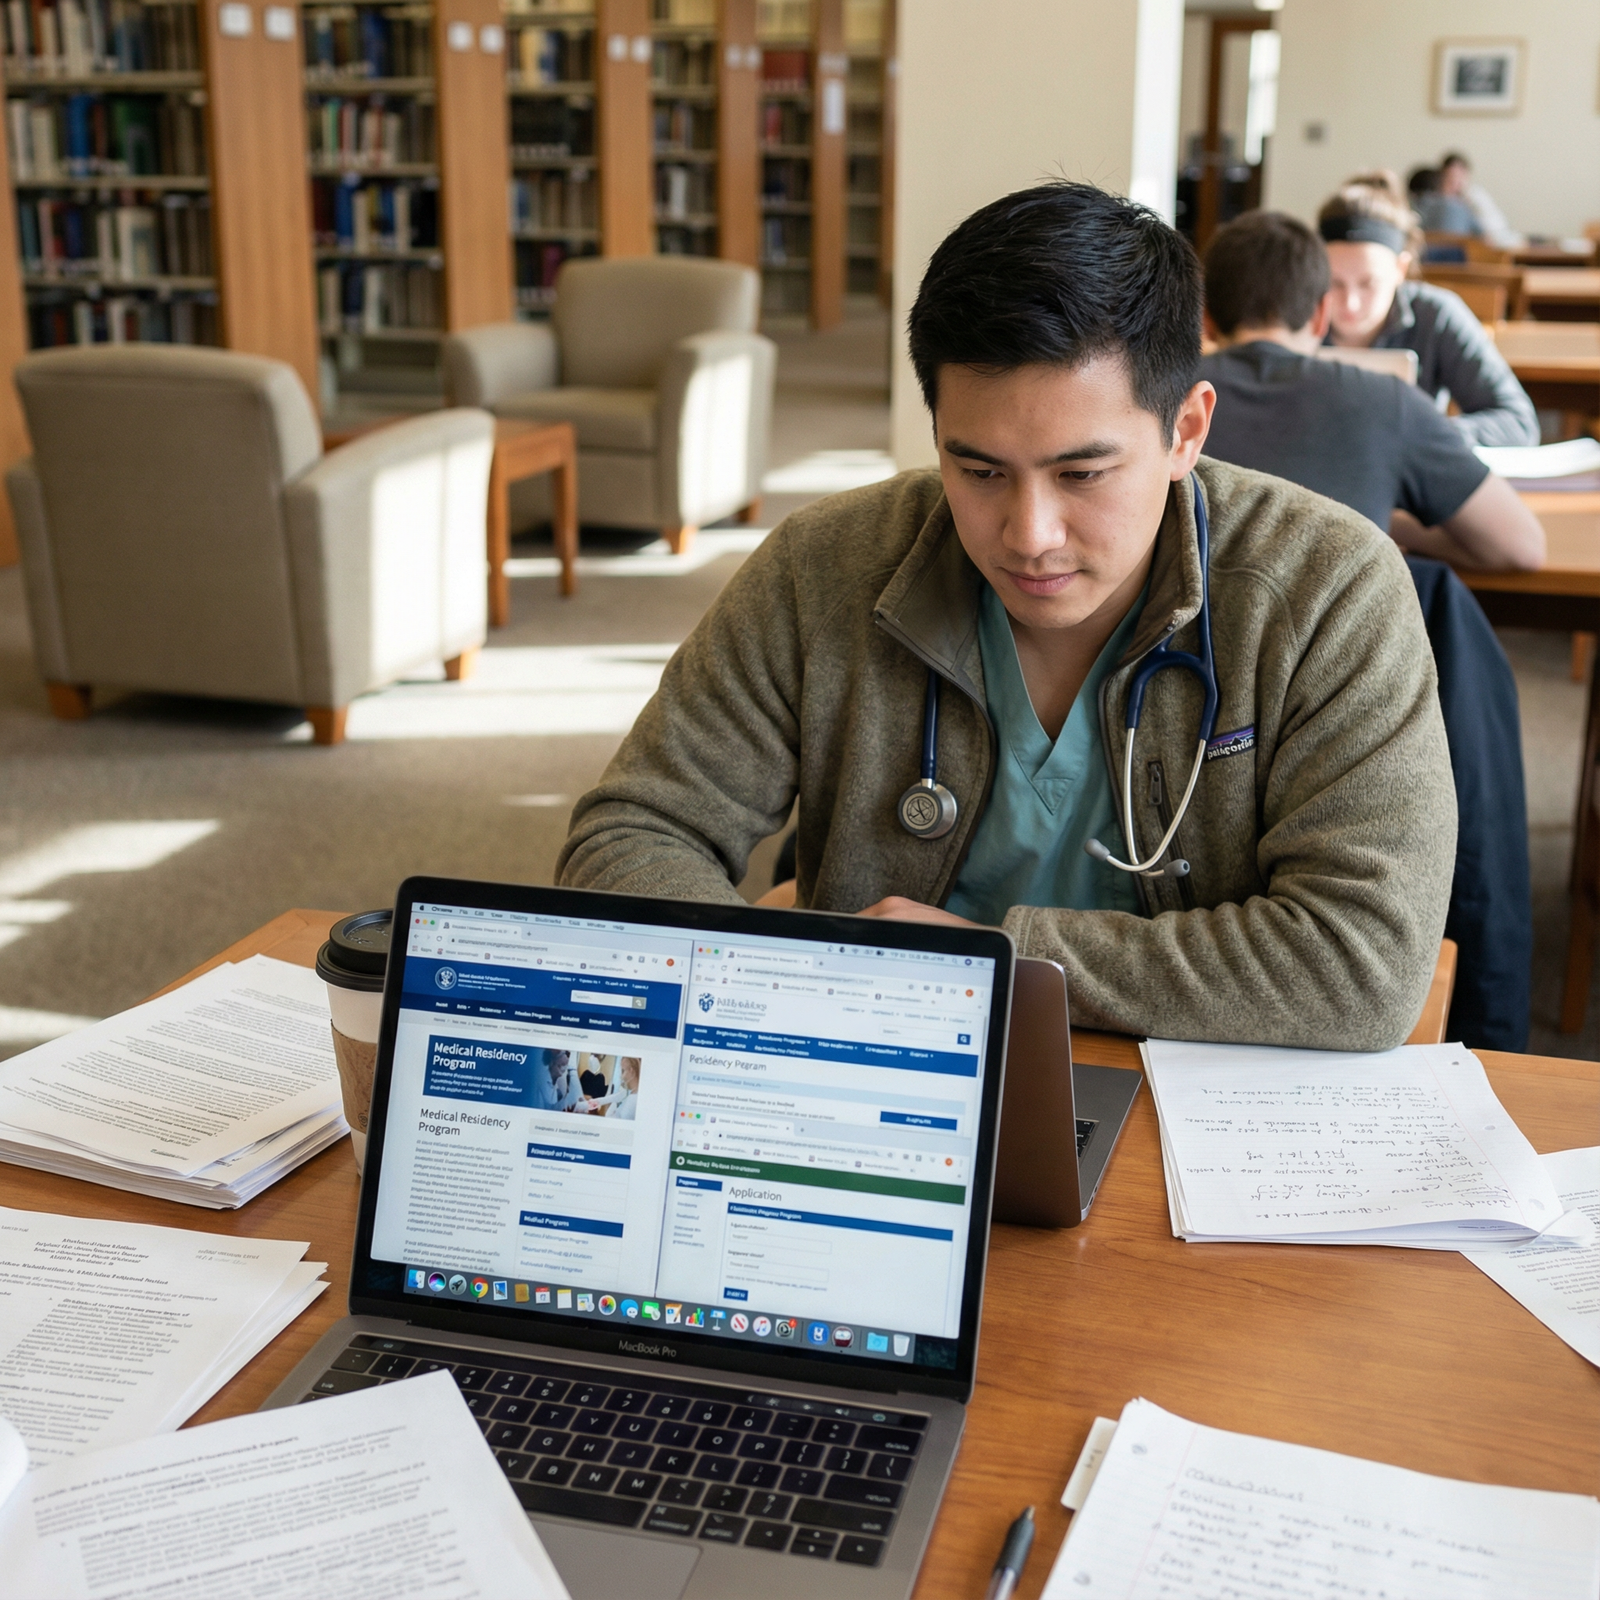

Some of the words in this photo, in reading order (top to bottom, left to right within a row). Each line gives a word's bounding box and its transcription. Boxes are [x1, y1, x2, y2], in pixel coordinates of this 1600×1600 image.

[434, 1042, 473, 1057] Medical
[475, 1047, 528, 1065] Residency
[432, 1055, 476, 1070] Program
[420, 1108, 458, 1122] Medical
[460, 1112, 511, 1130] Residency
[418, 1121, 461, 1136] Program
[729, 1186, 782, 1202] Application
[618, 1340, 660, 1356] MacBook
[661, 1346, 677, 1358] Pro
[507, 1404, 518, 1414] R
[550, 1411, 560, 1420] T
[590, 1417, 599, 1426] Y
[629, 1423, 641, 1432] U
[542, 1436, 554, 1447] G
[712, 1435, 723, 1446] O
[583, 1443, 596, 1453] H
[507, 1458, 518, 1469] V
[667, 1455, 679, 1466] K
[710, 1462, 719, 1473] L
[589, 1472, 601, 1483] N
[631, 1478, 646, 1490] M
